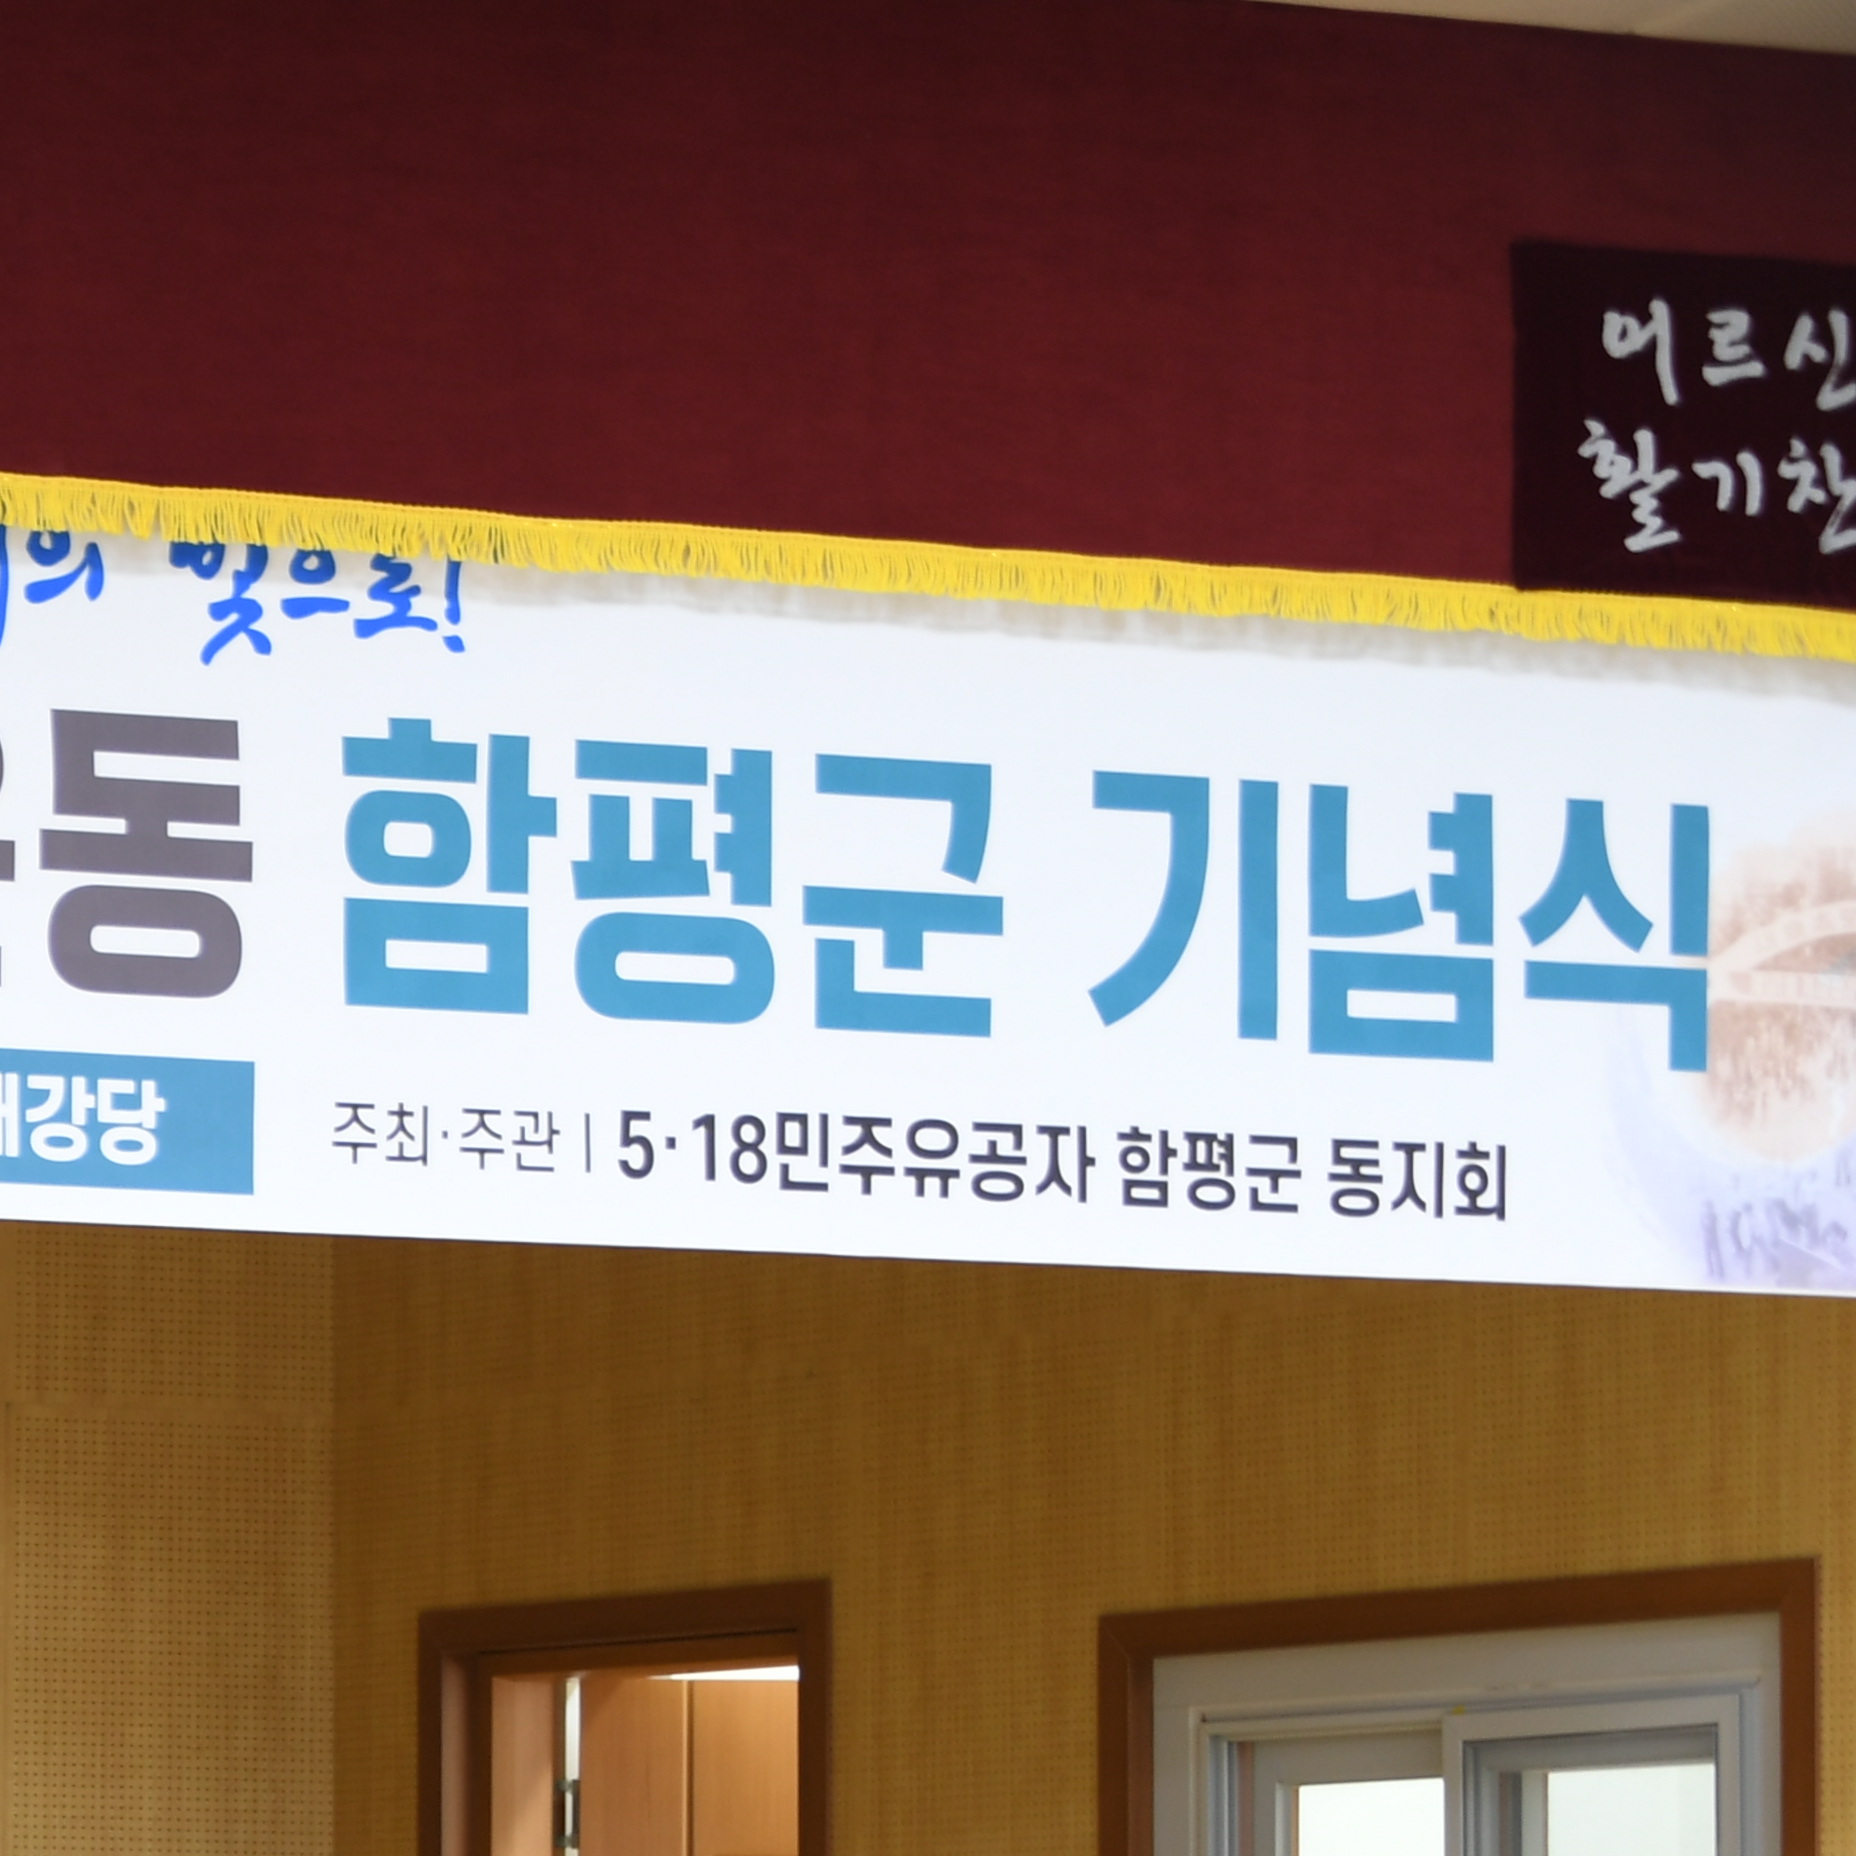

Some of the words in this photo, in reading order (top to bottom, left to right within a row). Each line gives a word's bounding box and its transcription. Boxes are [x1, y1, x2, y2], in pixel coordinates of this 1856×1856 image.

[1602, 299, 1856, 410] 어르신
[170, 543, 466, 665] 빛으로!
[343, 717, 1004, 1037] 함평군
[1090, 770, 1710, 1072] 기념식
[332, 1102, 561, 1172] 주최·주관
[617, 1110, 1097, 1205] 5·18민주유공자
[1116, 1125, 1302, 1214] 함평군
[1327, 1138, 1508, 1222] 동지회
